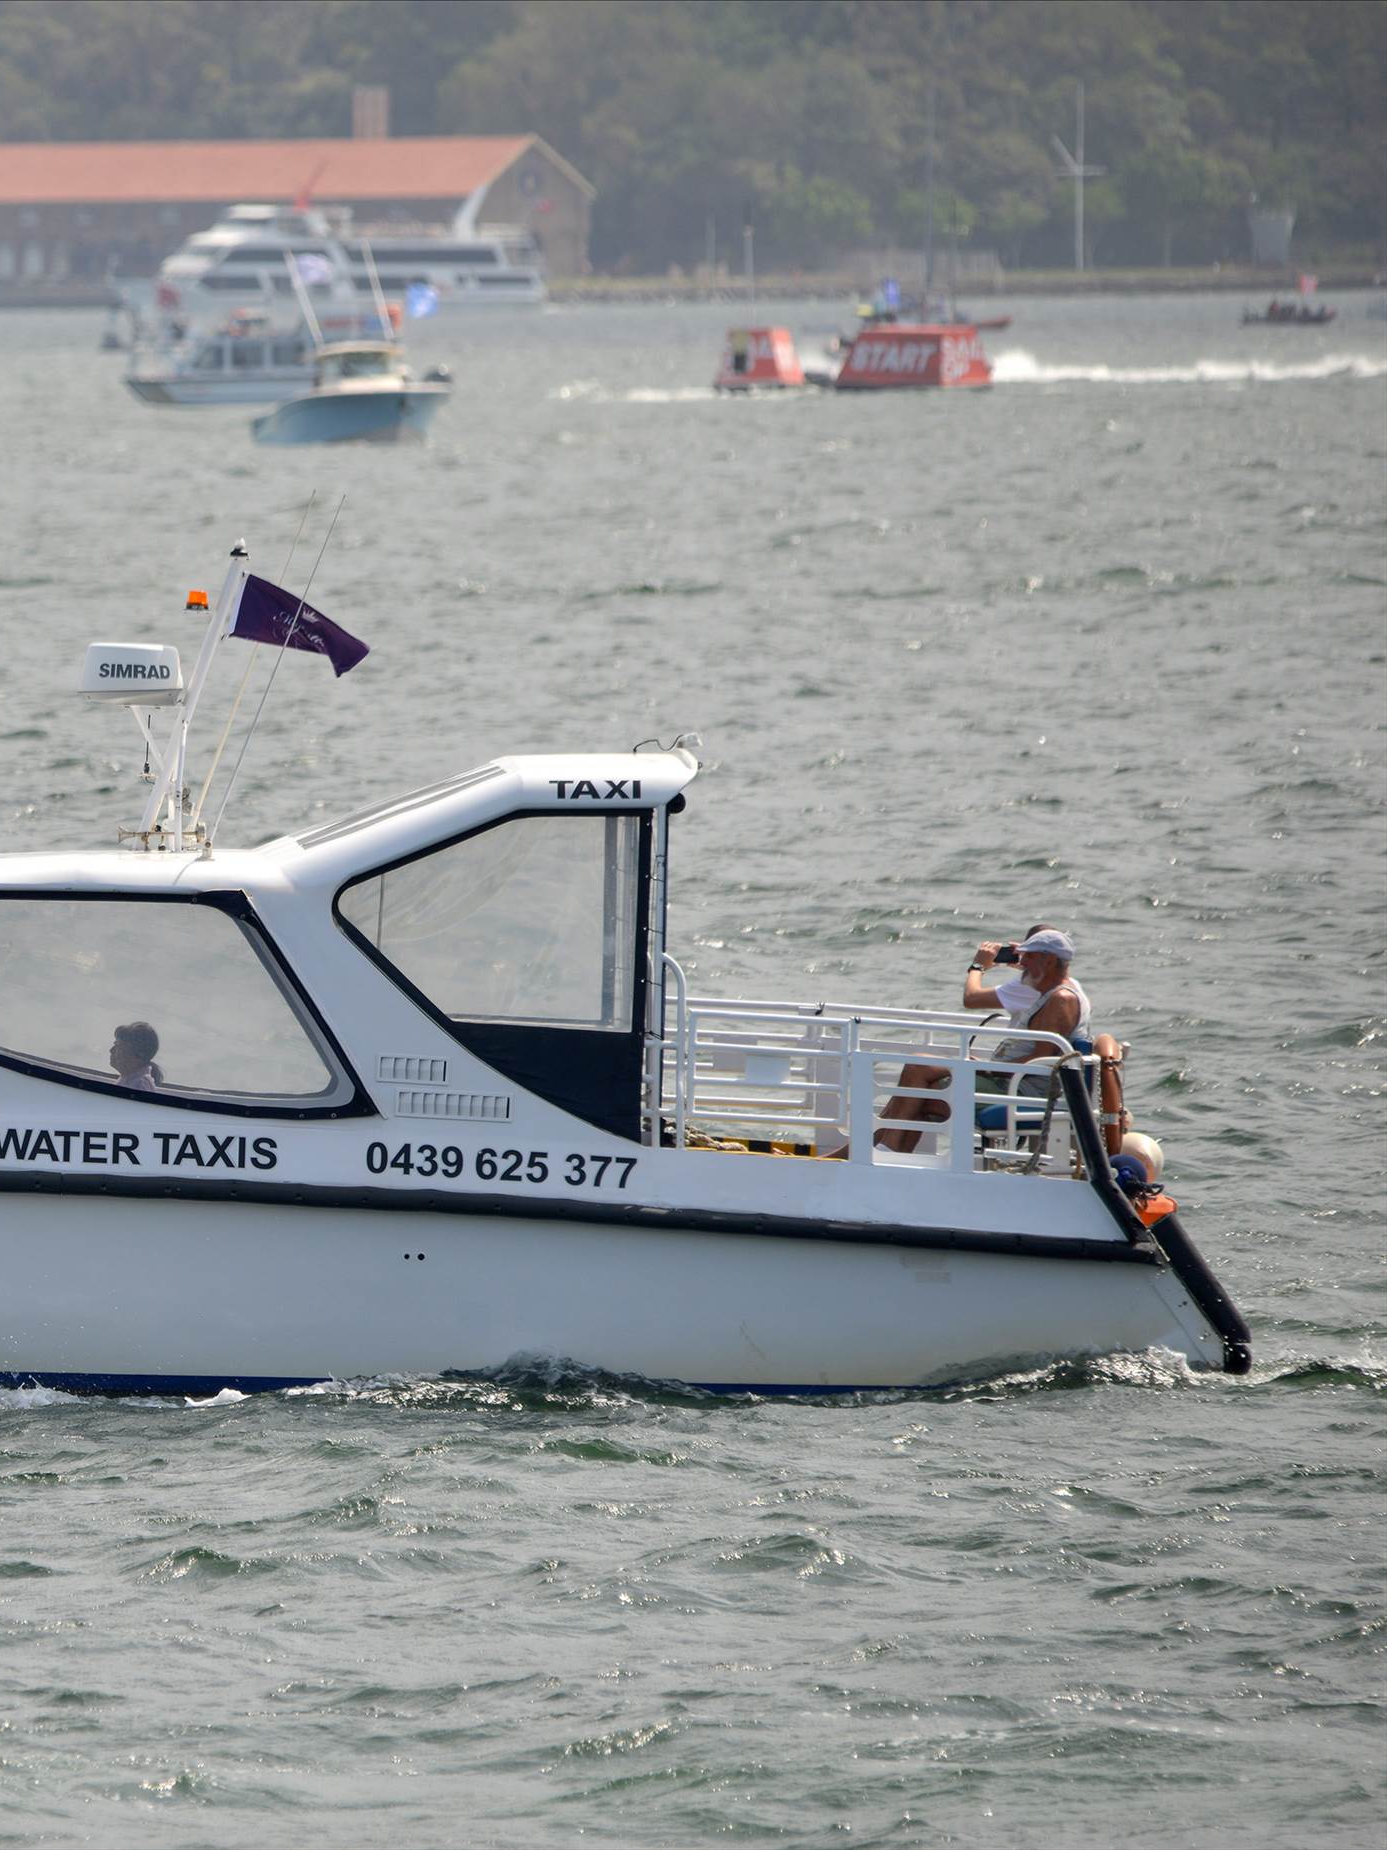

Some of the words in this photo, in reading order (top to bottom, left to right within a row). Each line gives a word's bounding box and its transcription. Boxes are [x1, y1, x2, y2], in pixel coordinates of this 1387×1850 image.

[850, 339, 939, 374] START
[99, 662, 170, 679] SIMRAD
[549, 780, 641, 800] TAXI
[153, 1132, 278, 1170] TAXIS
[366, 1141, 464, 1178] 0439
[475, 1148, 549, 1183] 625
[564, 1153, 638, 1189] 377
